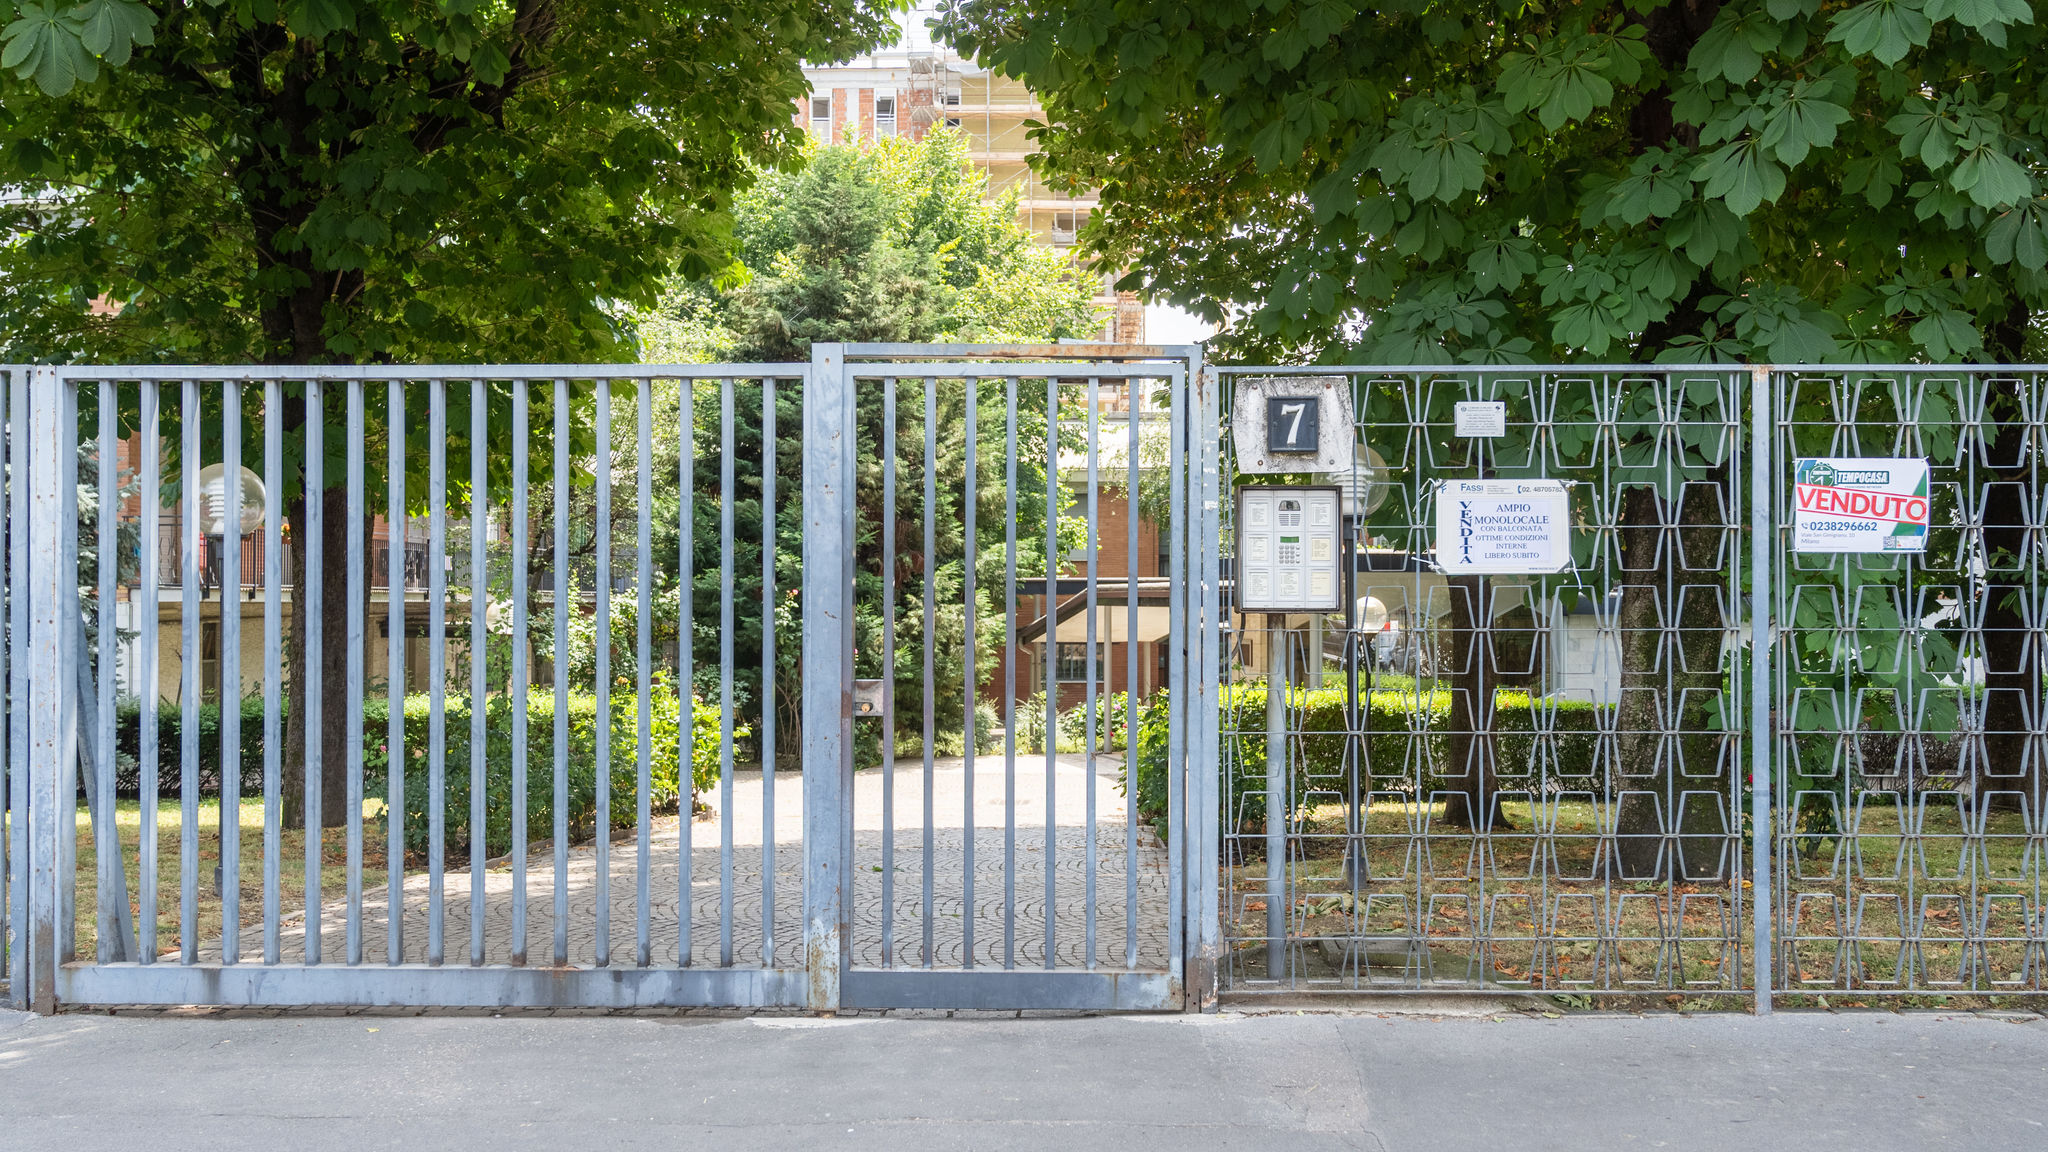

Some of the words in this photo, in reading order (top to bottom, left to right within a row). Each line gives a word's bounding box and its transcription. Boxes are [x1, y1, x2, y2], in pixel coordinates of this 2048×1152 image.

[1281, 403, 1306, 446] 7
[1837, 472, 1889, 483] TEMPOCASA
[1460, 483, 1484, 492] FASSI
[1496, 504, 1531, 512] AMPIO
[1797, 486, 1927, 521] VENDUTO
[1474, 516, 1549, 524] MONOLOCALE
[1810, 521, 1878, 531] 0238296662
[1459, 501, 1473, 564] VENDITA
